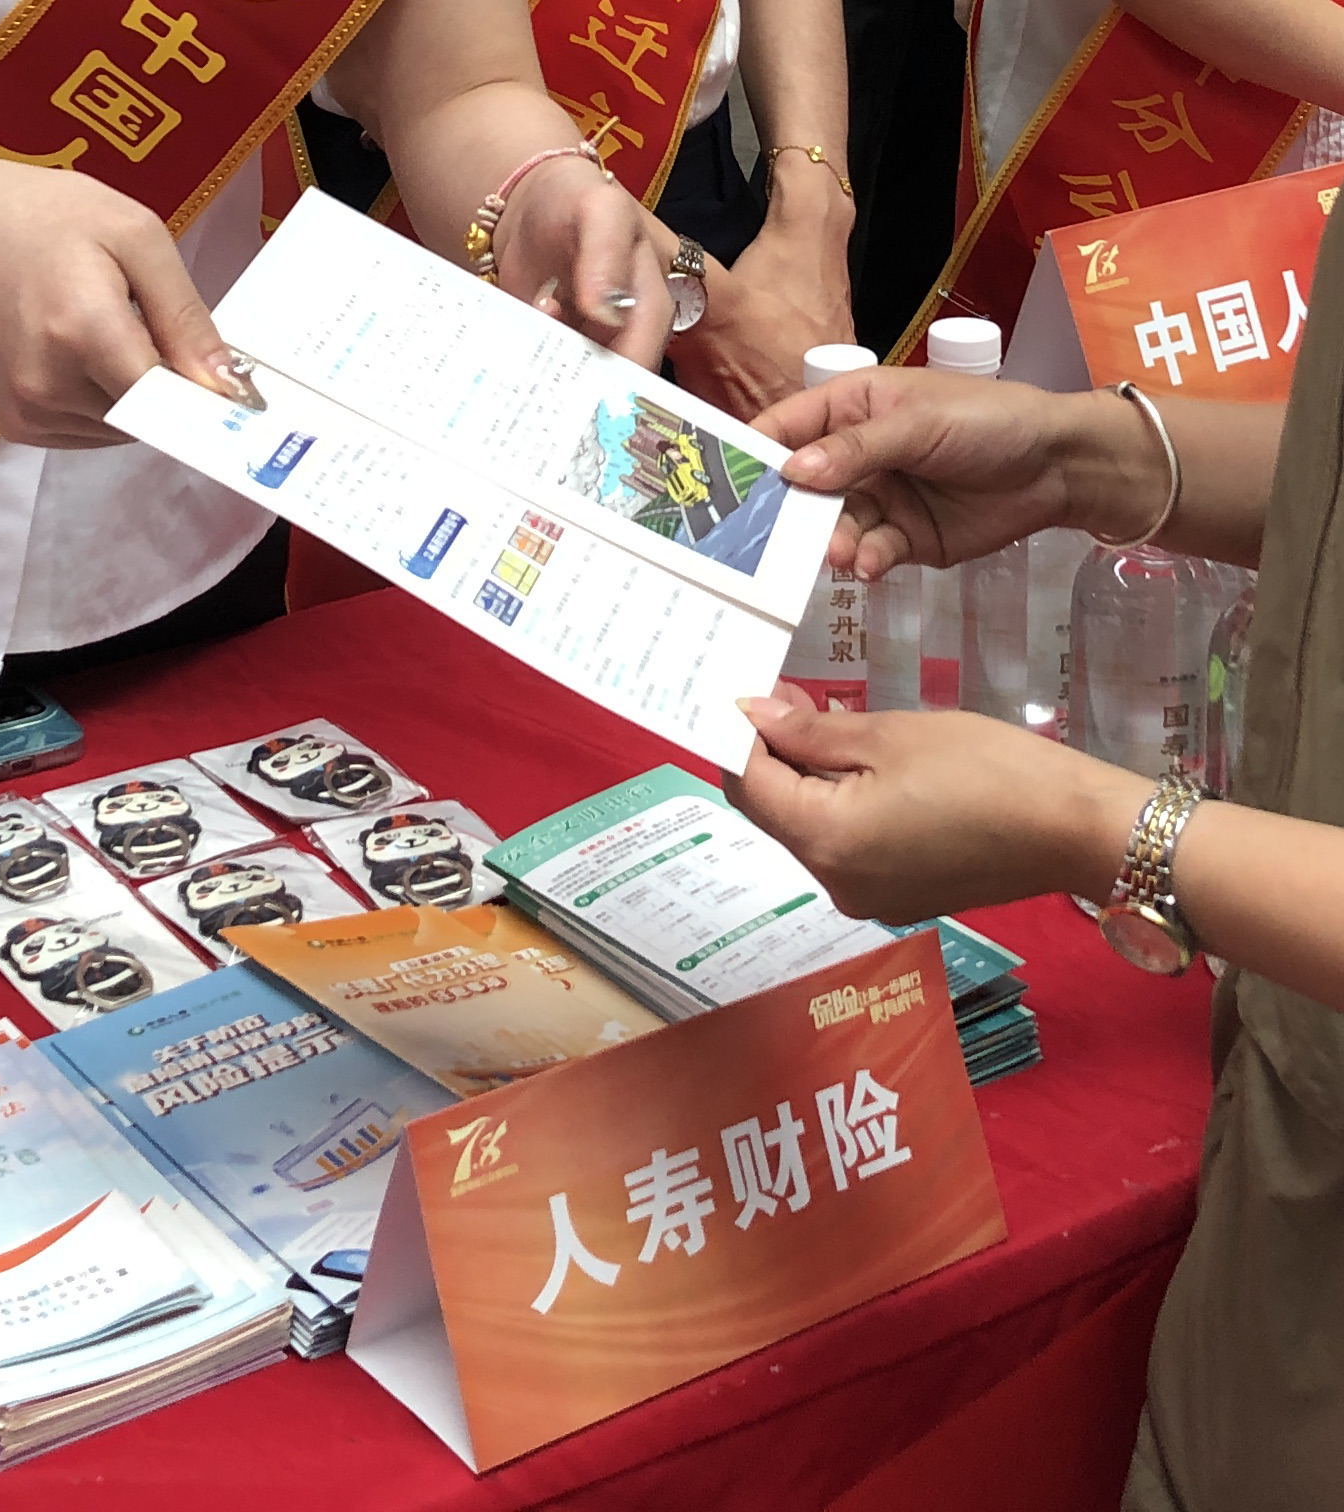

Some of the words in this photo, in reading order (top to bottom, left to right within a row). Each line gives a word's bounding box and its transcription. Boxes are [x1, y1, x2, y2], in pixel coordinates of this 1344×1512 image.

[143, 1023, 344, 1118] 风险提示
[530, 1068, 912, 1315] 人寿财险
